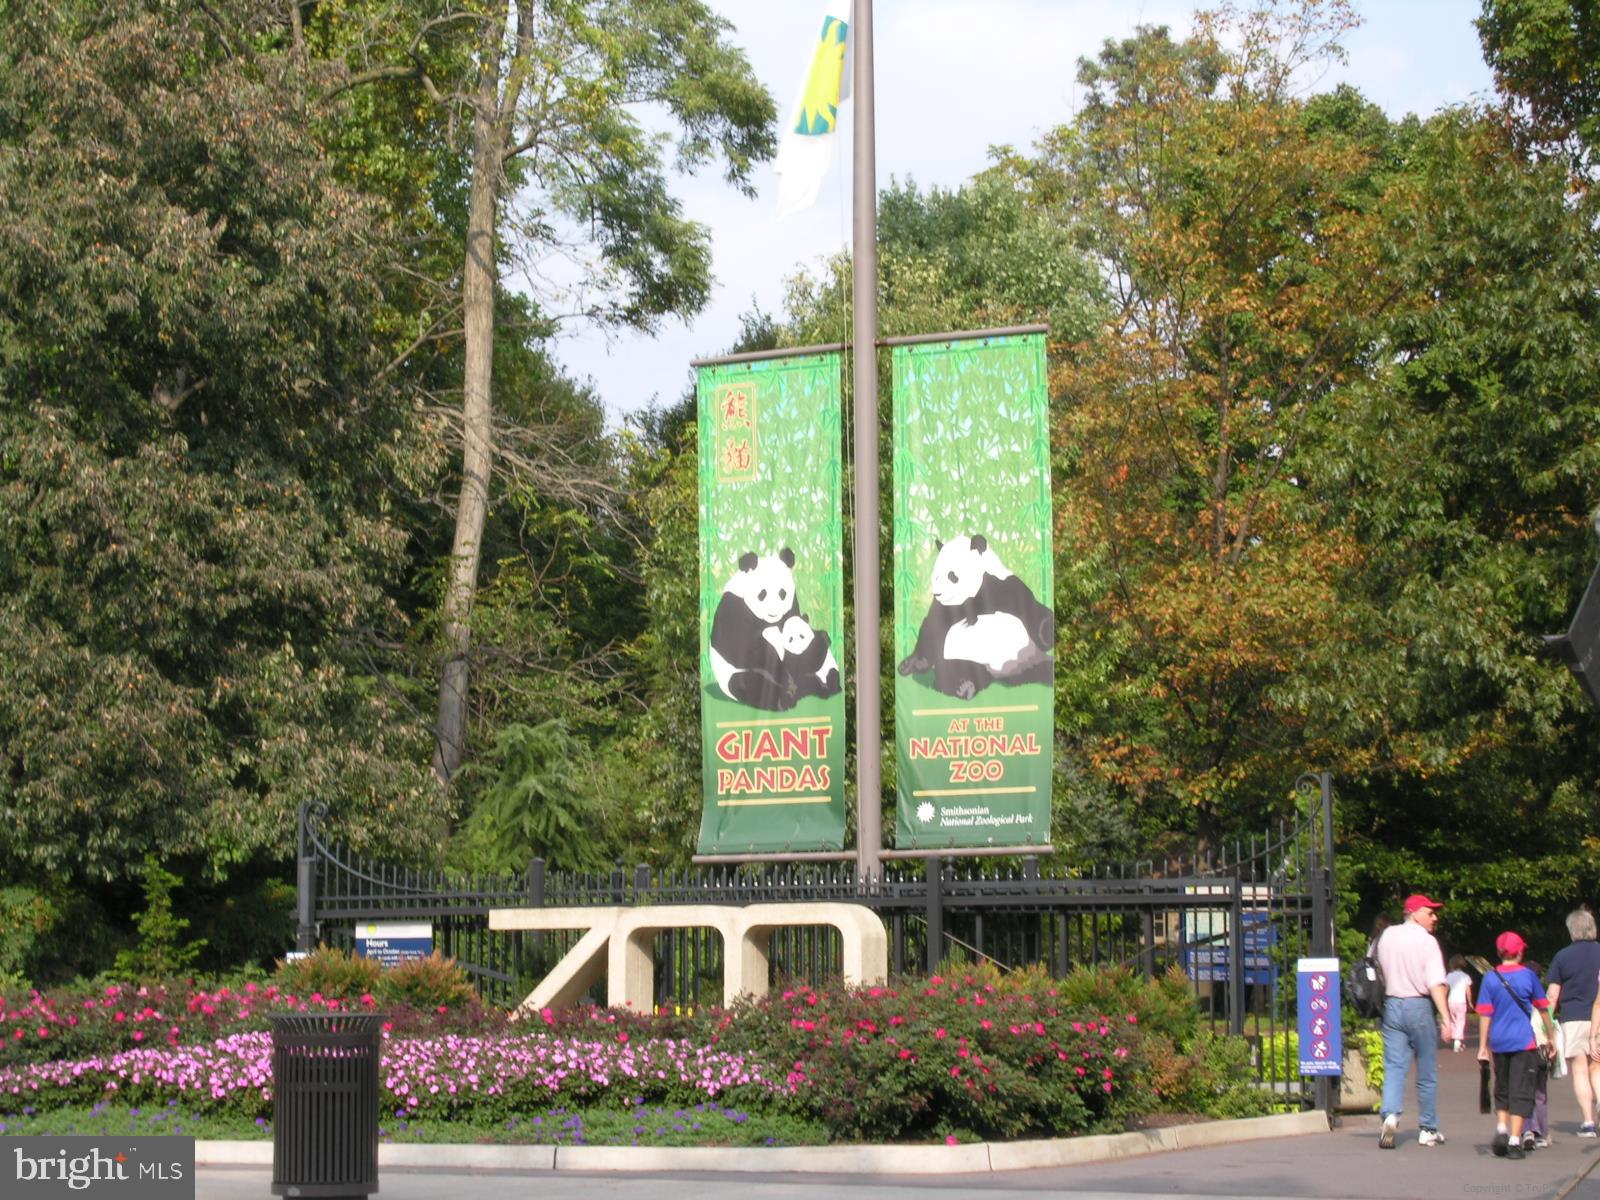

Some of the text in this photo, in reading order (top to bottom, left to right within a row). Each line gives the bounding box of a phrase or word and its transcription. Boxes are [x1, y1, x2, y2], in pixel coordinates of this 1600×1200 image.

[948, 717, 1004, 733] AT THE
[716, 726, 832, 763] GIANT
[909, 732, 1041, 759] NATIONAL
[718, 765, 831, 795] PANDAS
[949, 760, 1004, 783] ZOO
[940, 805, 989, 817] Smithsonian
[940, 813, 1033, 827] National Zoological Park
[366, 939, 388, 948] Hours
